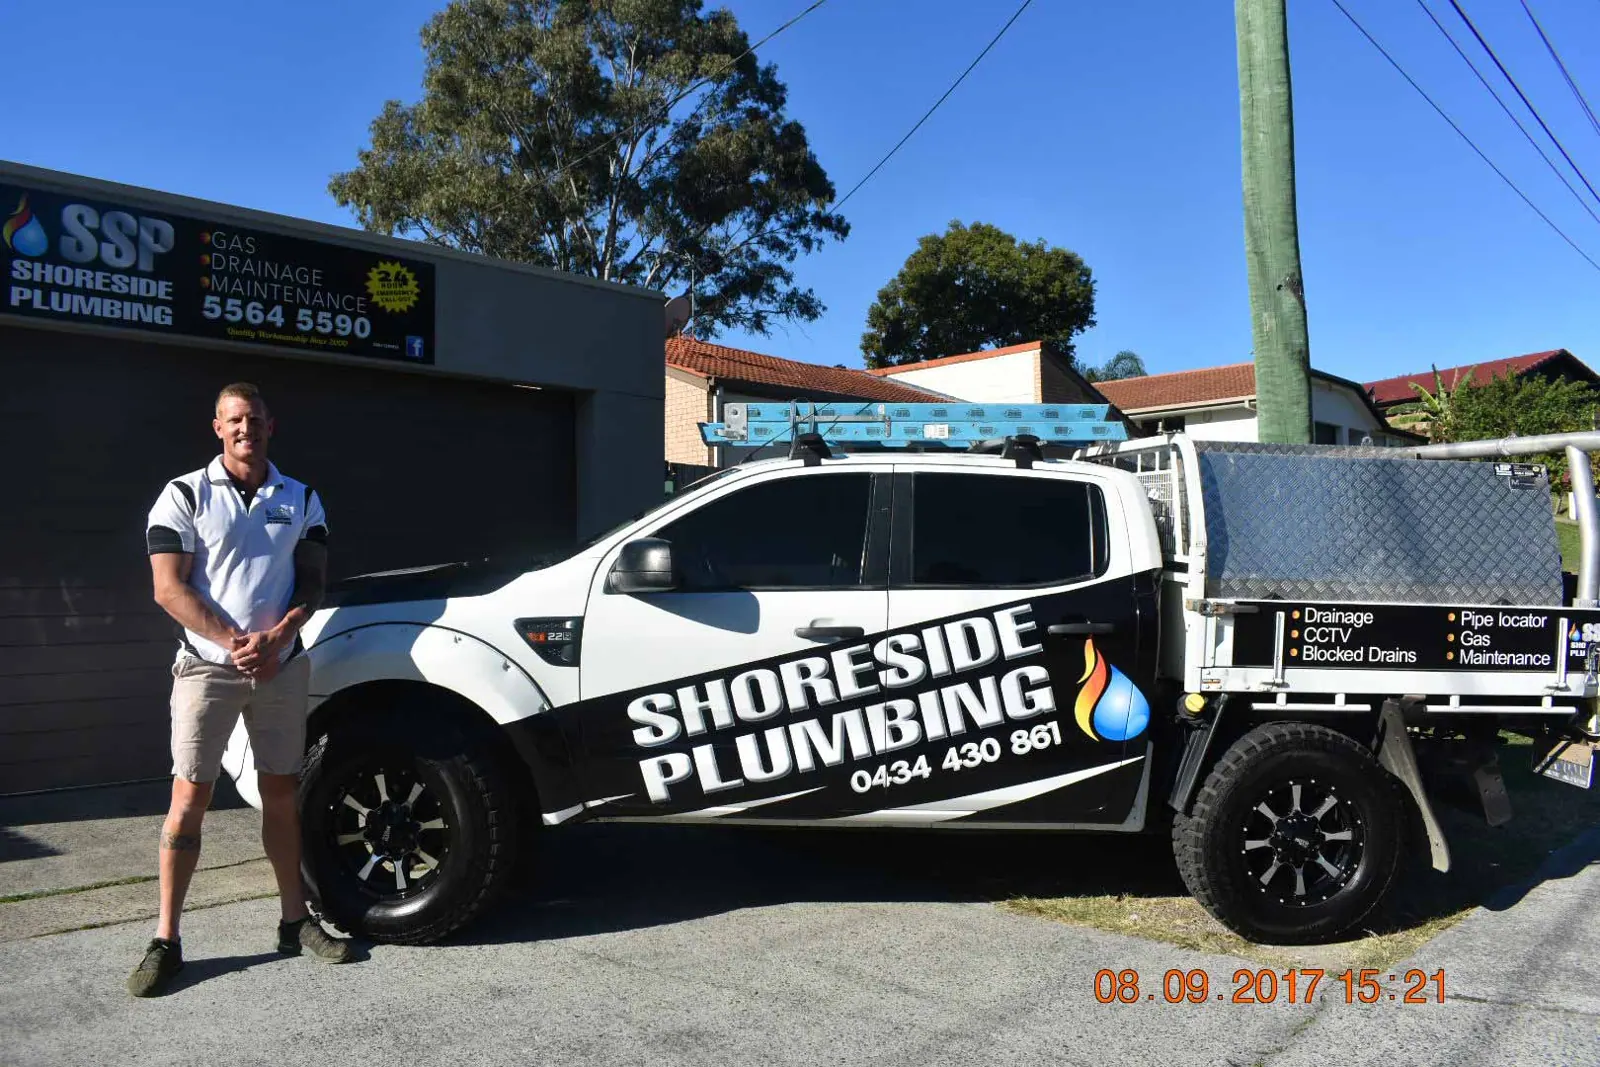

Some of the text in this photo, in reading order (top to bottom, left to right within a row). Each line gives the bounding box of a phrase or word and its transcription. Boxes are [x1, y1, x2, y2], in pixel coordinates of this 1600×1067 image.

[59, 203, 174, 272] SSP
[211, 231, 256, 254] GAS
[11, 259, 173, 300] SHORESIDE
[211, 252, 324, 286] DRAINAGE
[376, 270, 408, 286] 24
[10, 286, 173, 325] PLUMBING
[211, 274, 367, 314] MAINTENANCE
[202, 295, 371, 339] 5564 5590
[1304, 608, 1374, 626] Drainage
[1461, 611, 1547, 629] Pipe locator
[1303, 627, 1352, 643] CCTV
[1460, 631, 1491, 647] Gas
[1302, 646, 1417, 663] Blocked Drains
[1459, 649, 1551, 666] Maintenance
[626, 603, 1043, 747] SHORESIDE
[639, 664, 1058, 804] PLUMBING
[849, 719, 1062, 795] 0434 430 861
